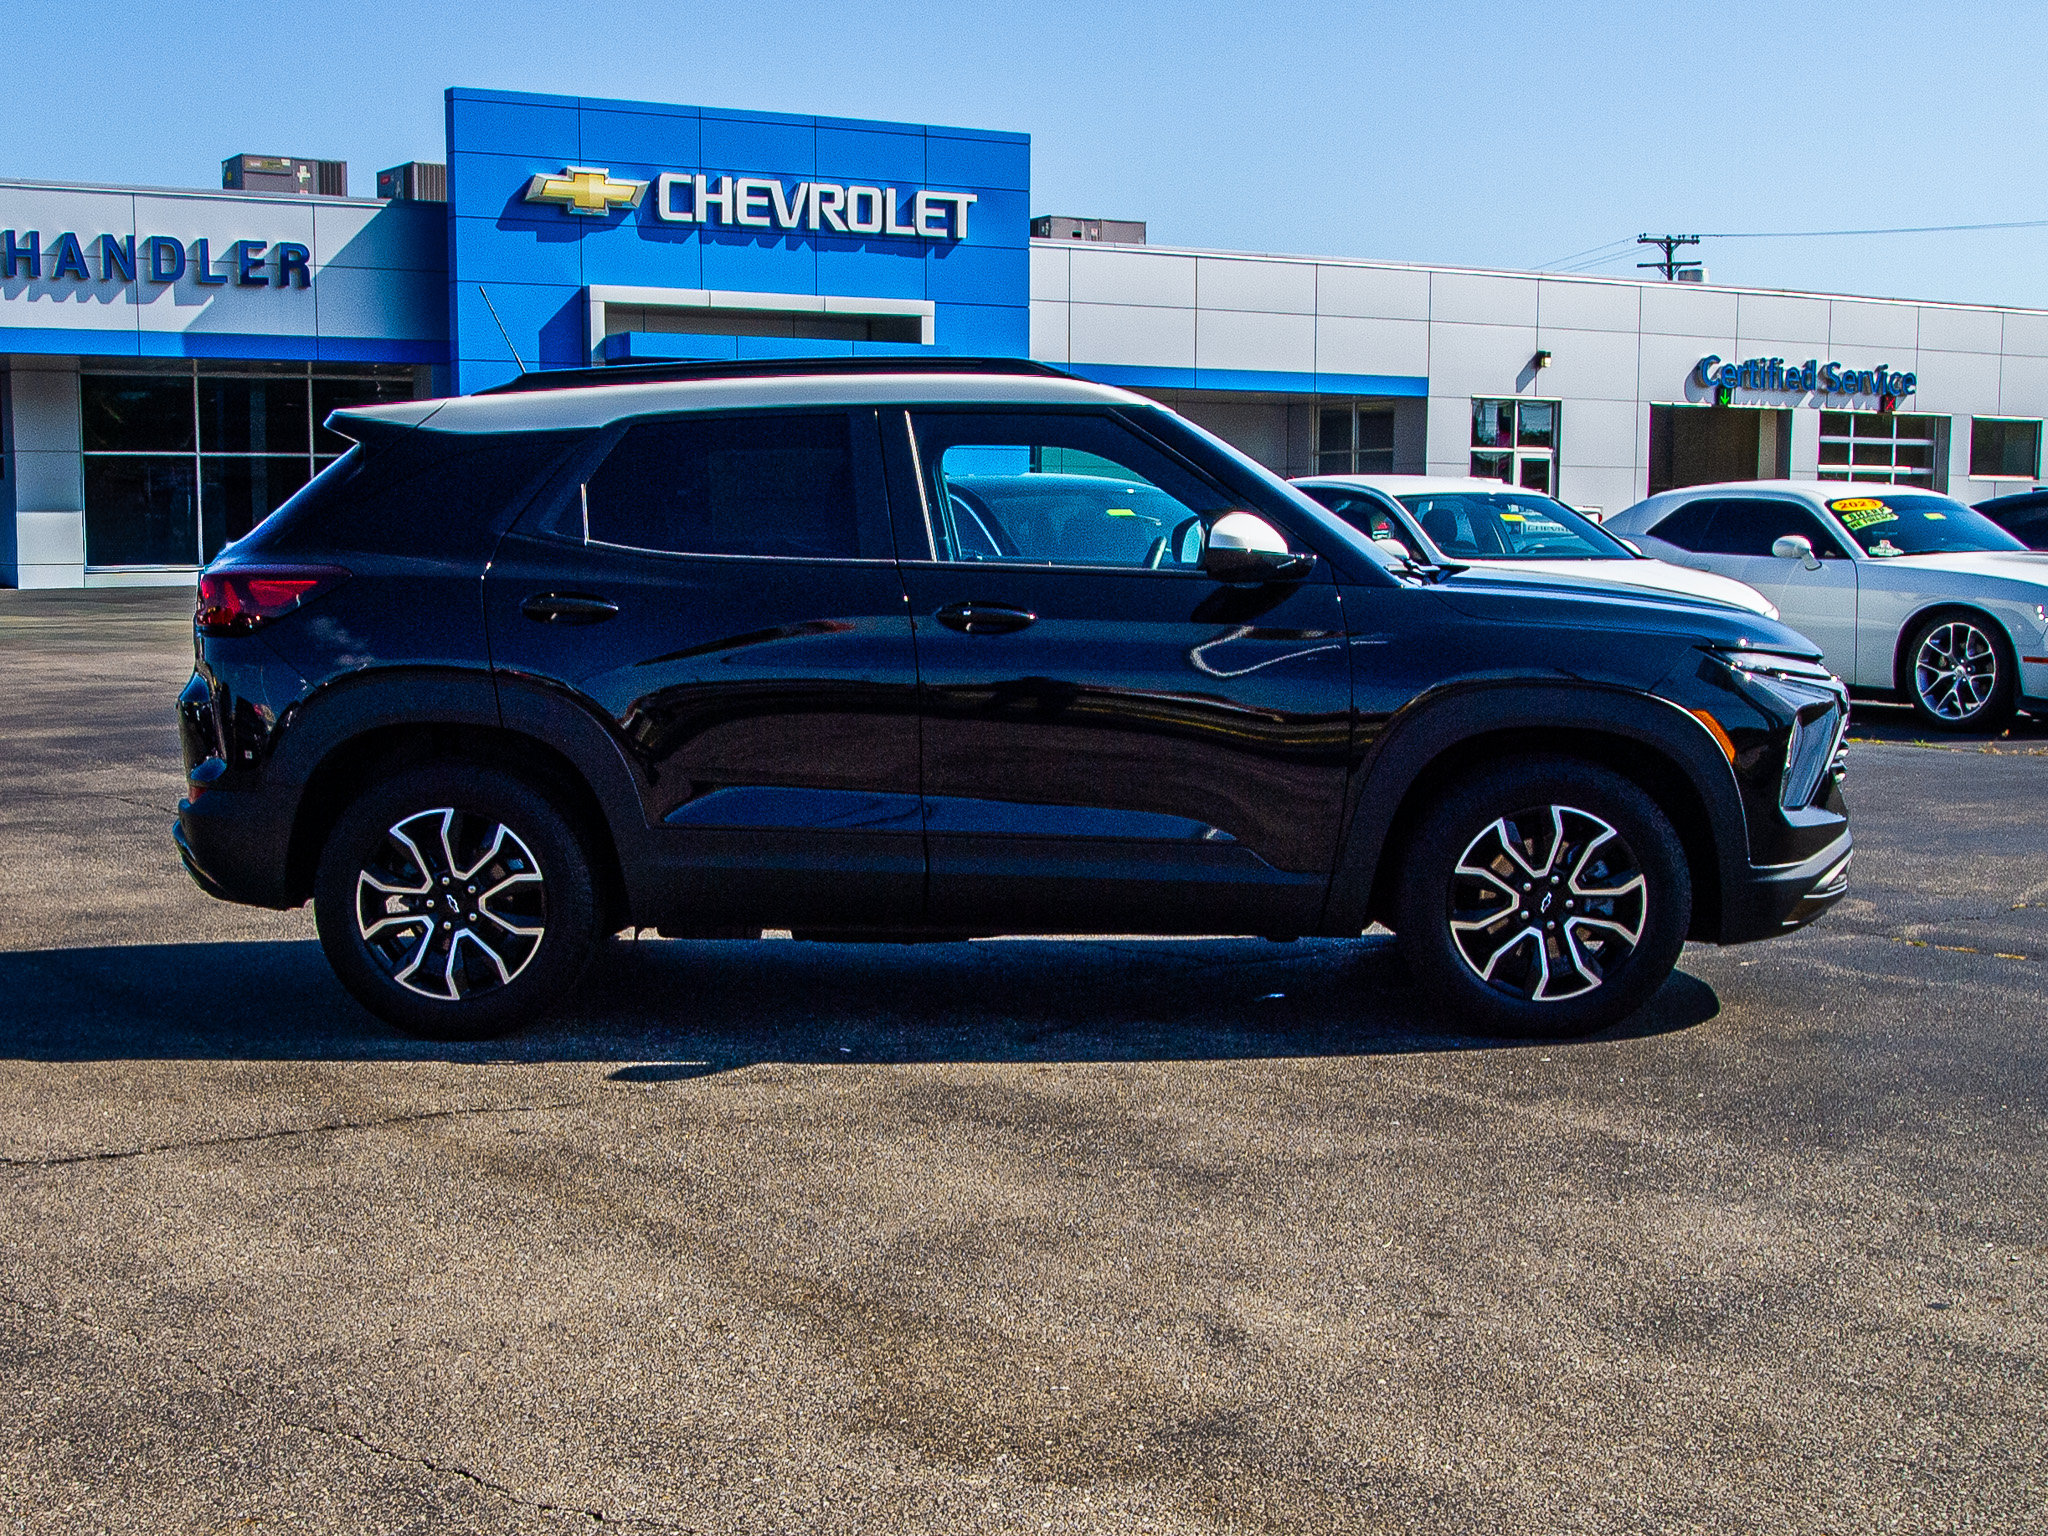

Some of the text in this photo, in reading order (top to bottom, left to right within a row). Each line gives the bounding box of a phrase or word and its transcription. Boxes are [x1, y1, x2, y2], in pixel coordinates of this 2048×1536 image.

[658, 172, 978, 239] CHEVROLET
[1702, 355, 1916, 396] Certified Service
[1839, 500, 1878, 510] 2023
